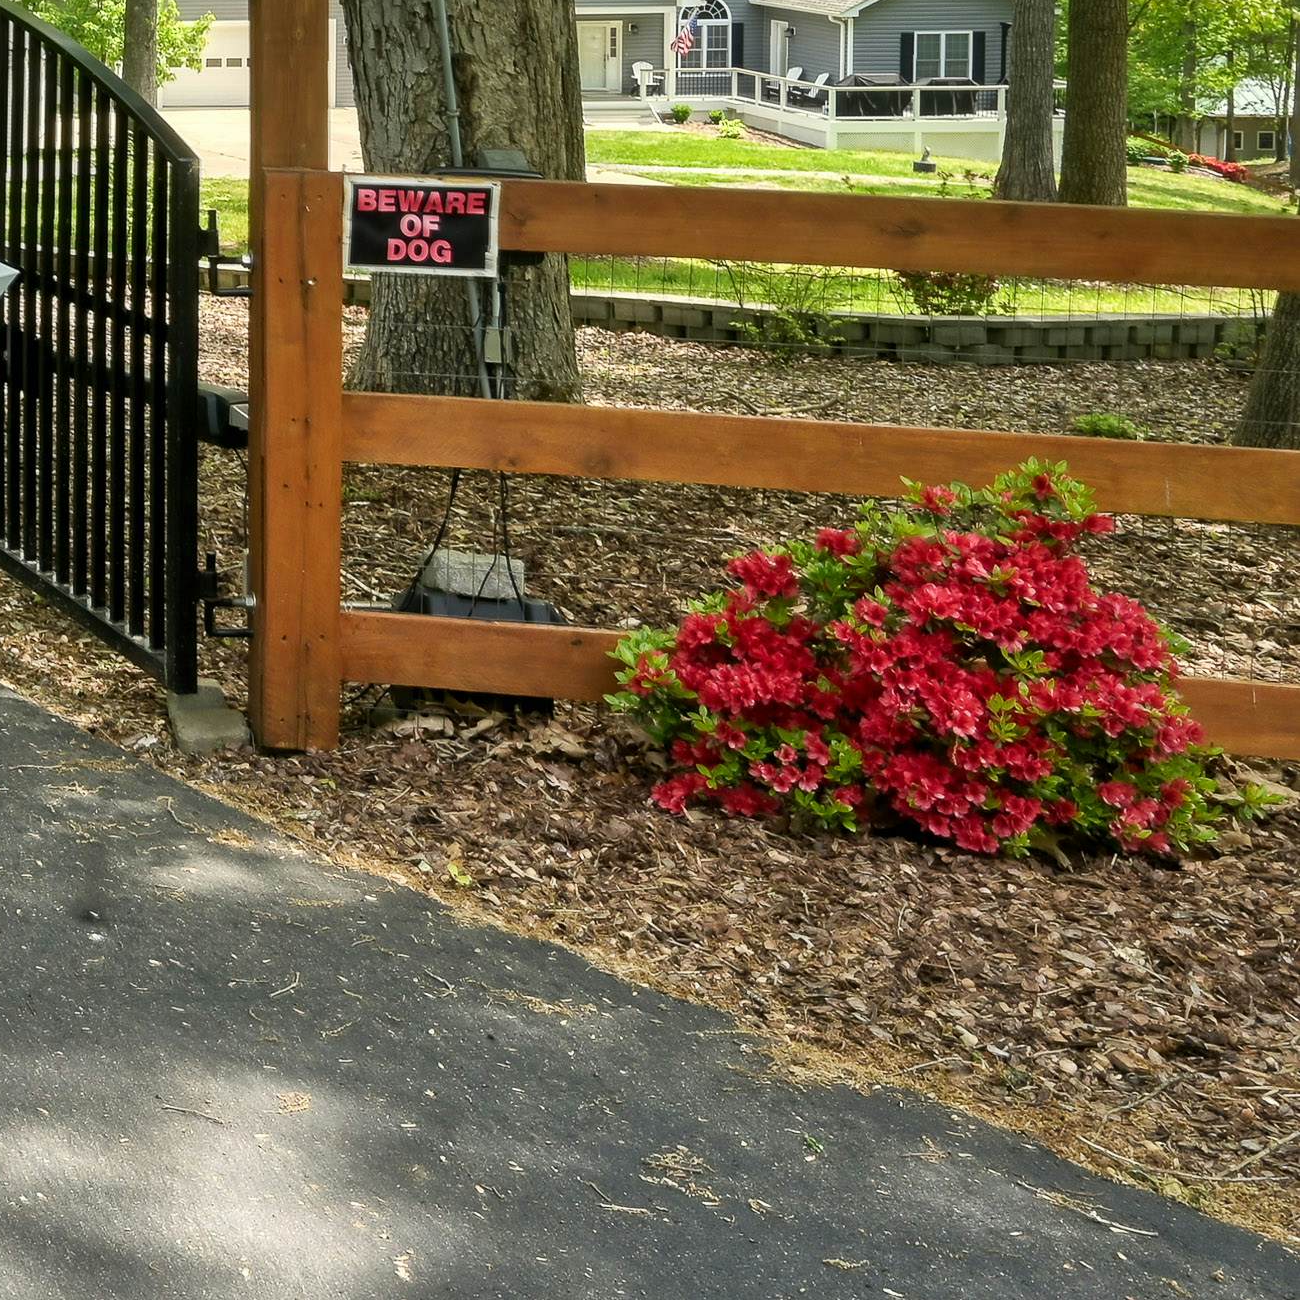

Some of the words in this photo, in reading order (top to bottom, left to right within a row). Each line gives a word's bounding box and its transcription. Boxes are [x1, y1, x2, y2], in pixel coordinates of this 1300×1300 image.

[357, 189, 487, 215] BEWARE
[400, 213, 441, 238] OF
[387, 238, 453, 263] DOG
